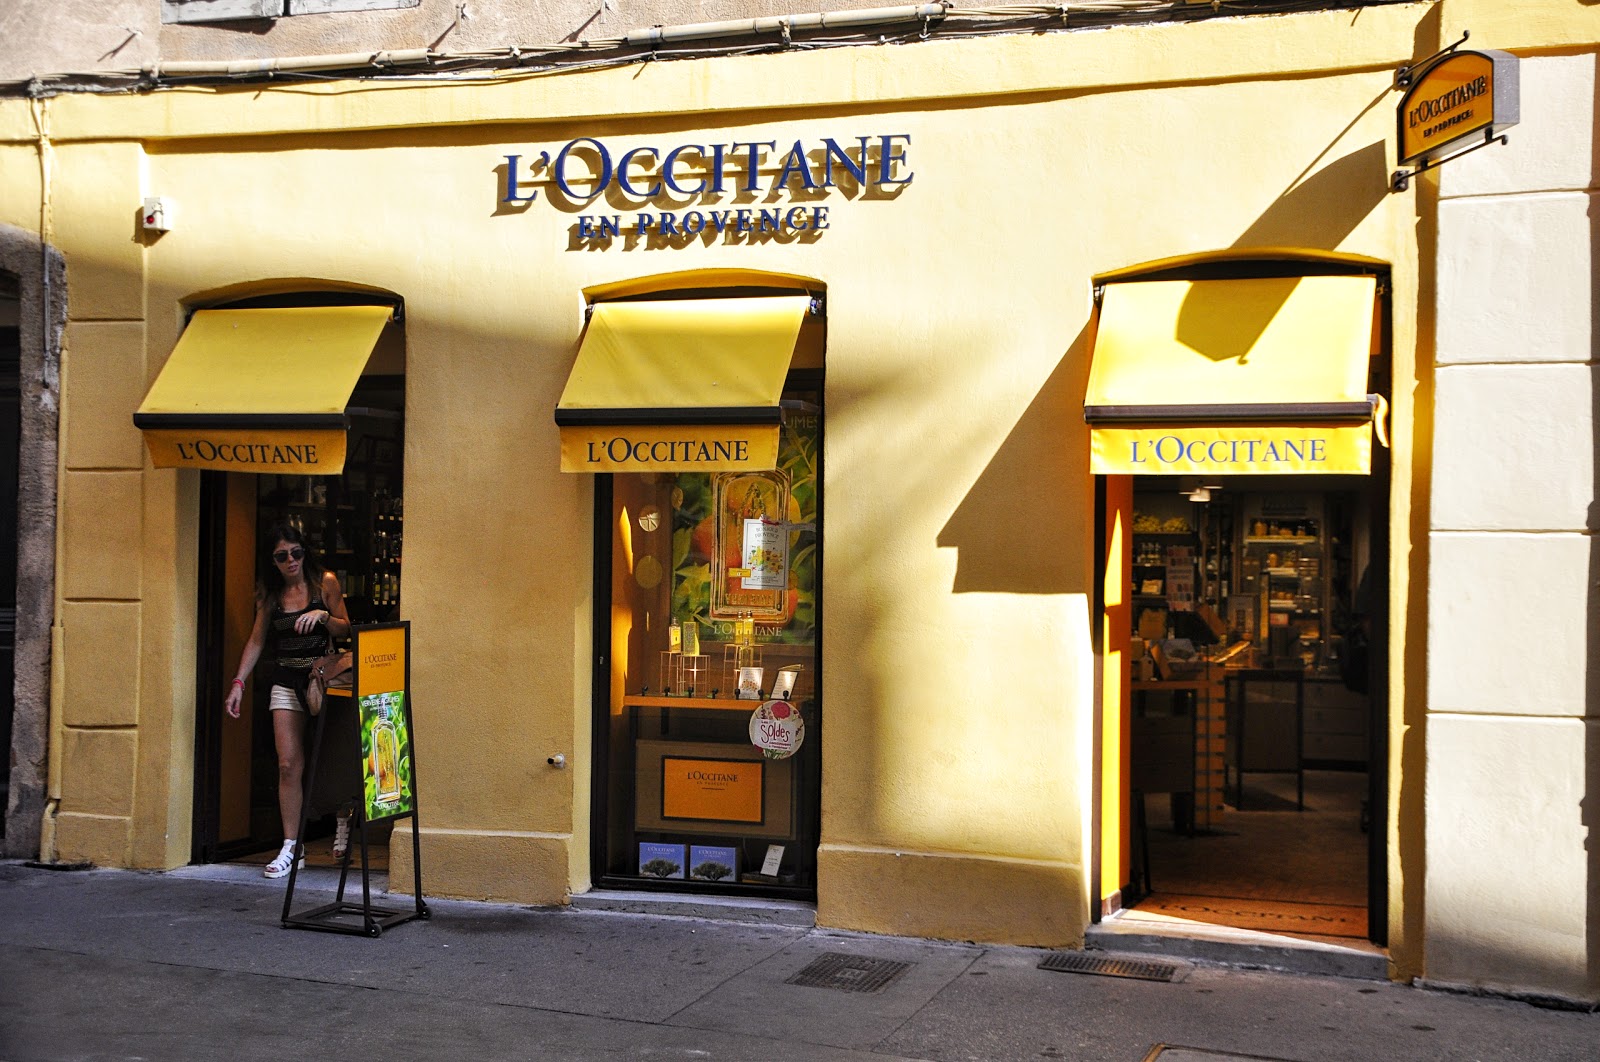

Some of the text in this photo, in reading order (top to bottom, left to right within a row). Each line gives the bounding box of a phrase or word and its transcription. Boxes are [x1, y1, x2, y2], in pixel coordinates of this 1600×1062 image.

[1409, 75, 1487, 129] L'OCCITANE
[503, 134, 915, 202] L'OCCITANE
[577, 206, 831, 239] EN PROVENCE
[176, 439, 319, 465] L'OCCITANE
[587, 437, 749, 463] L'OCCITANE
[1129, 435, 1327, 464] L'OCCITANE
[364, 653, 397, 664] L'OCCITANE
[760, 721, 791, 744] Soldes
[687, 770, 739, 782] L'OCCITANE
